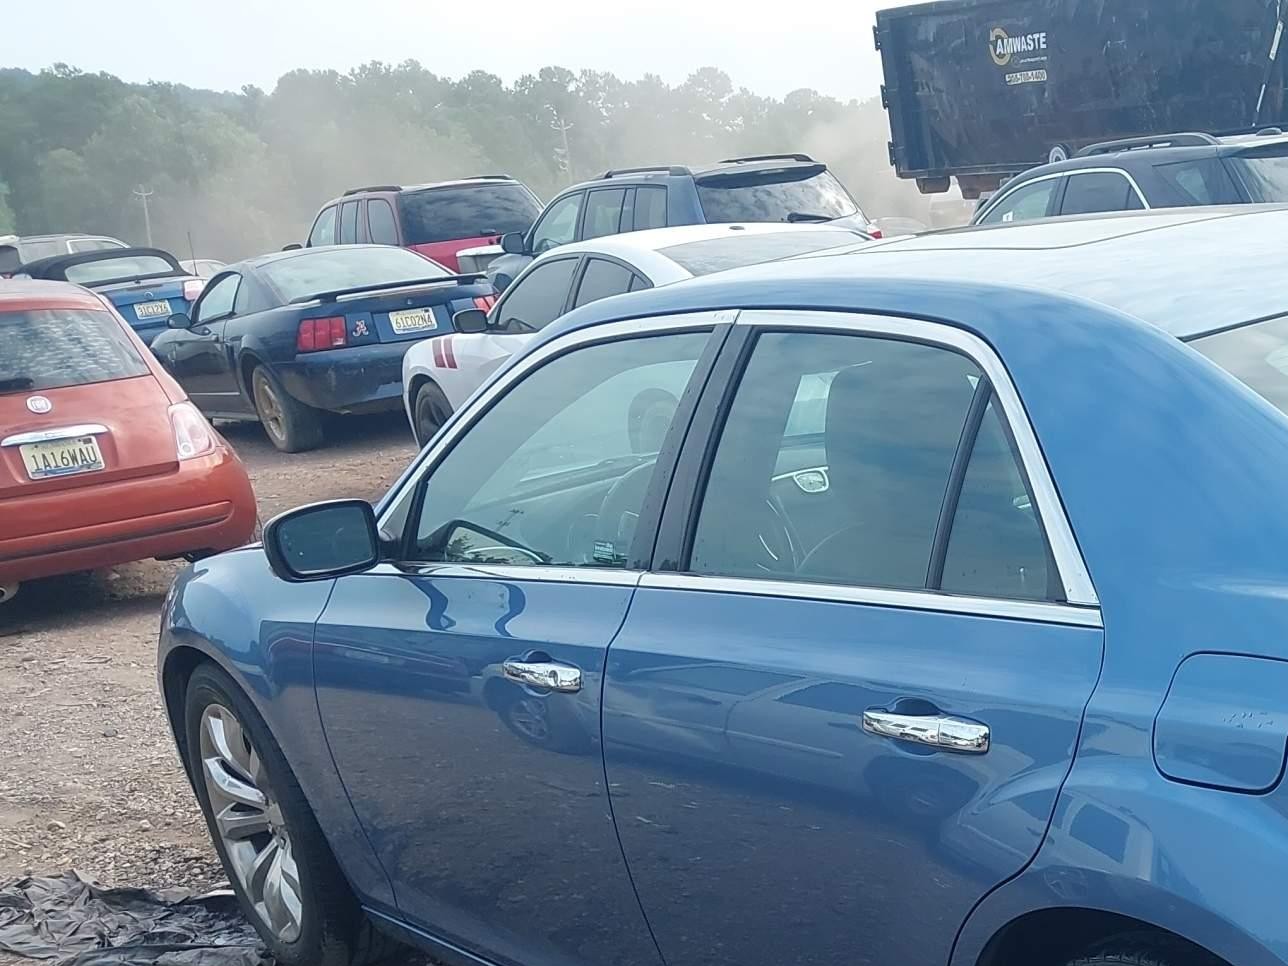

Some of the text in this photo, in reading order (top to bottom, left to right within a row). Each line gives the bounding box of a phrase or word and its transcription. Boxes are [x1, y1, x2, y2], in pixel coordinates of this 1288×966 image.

[996, 32, 1047, 55] AMWASTE
[395, 313, 433, 329] 61C02N4
[31, 445, 98, 472] 1A16WAU
